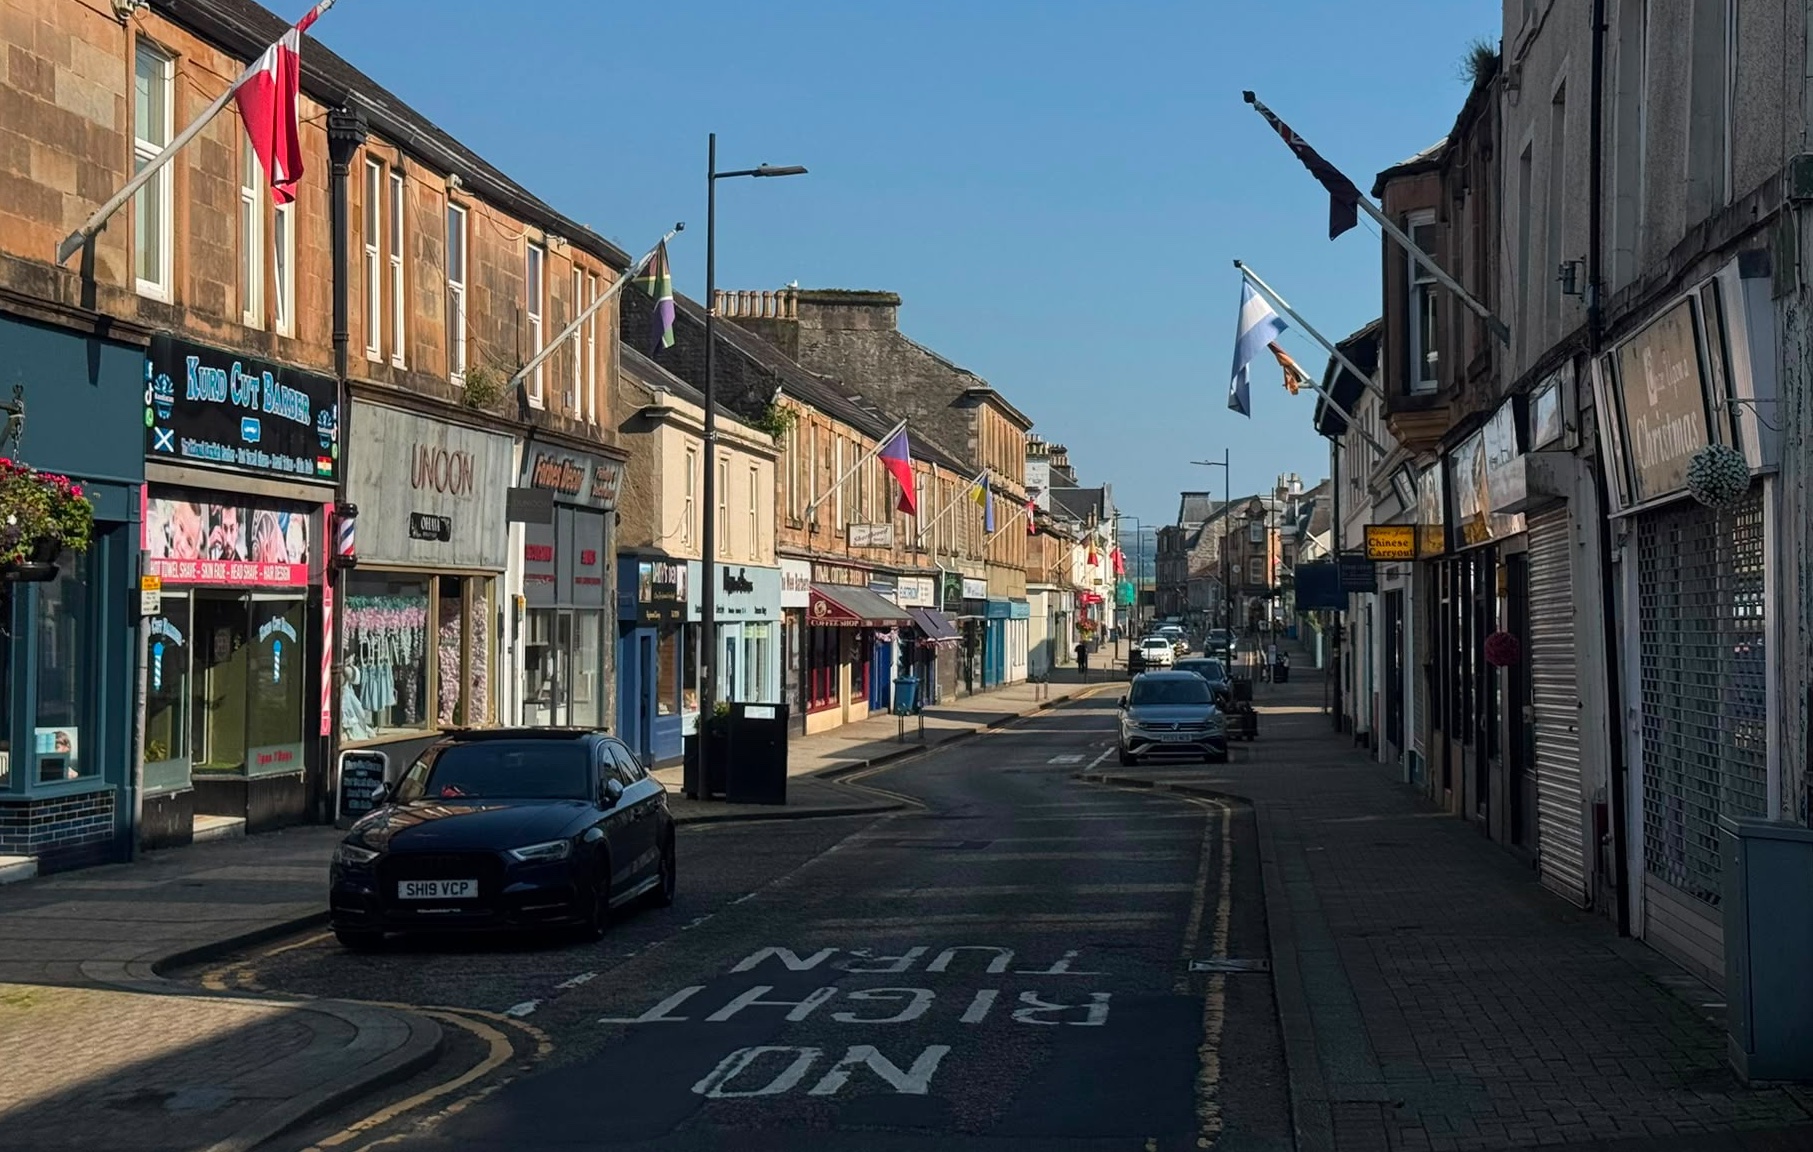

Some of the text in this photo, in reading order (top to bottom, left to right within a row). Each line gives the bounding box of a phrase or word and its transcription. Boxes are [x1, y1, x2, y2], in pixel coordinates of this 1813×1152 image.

[1636, 410, 1699, 469] Christmas
[1368, 537, 1409, 547] Chinese
[1368, 547, 1414, 559] Carryout
[407, 882, 469, 896] SH19 VCP
[598, 985, 1112, 1026] RIGHT
[691, 1044, 951, 1098] NO
